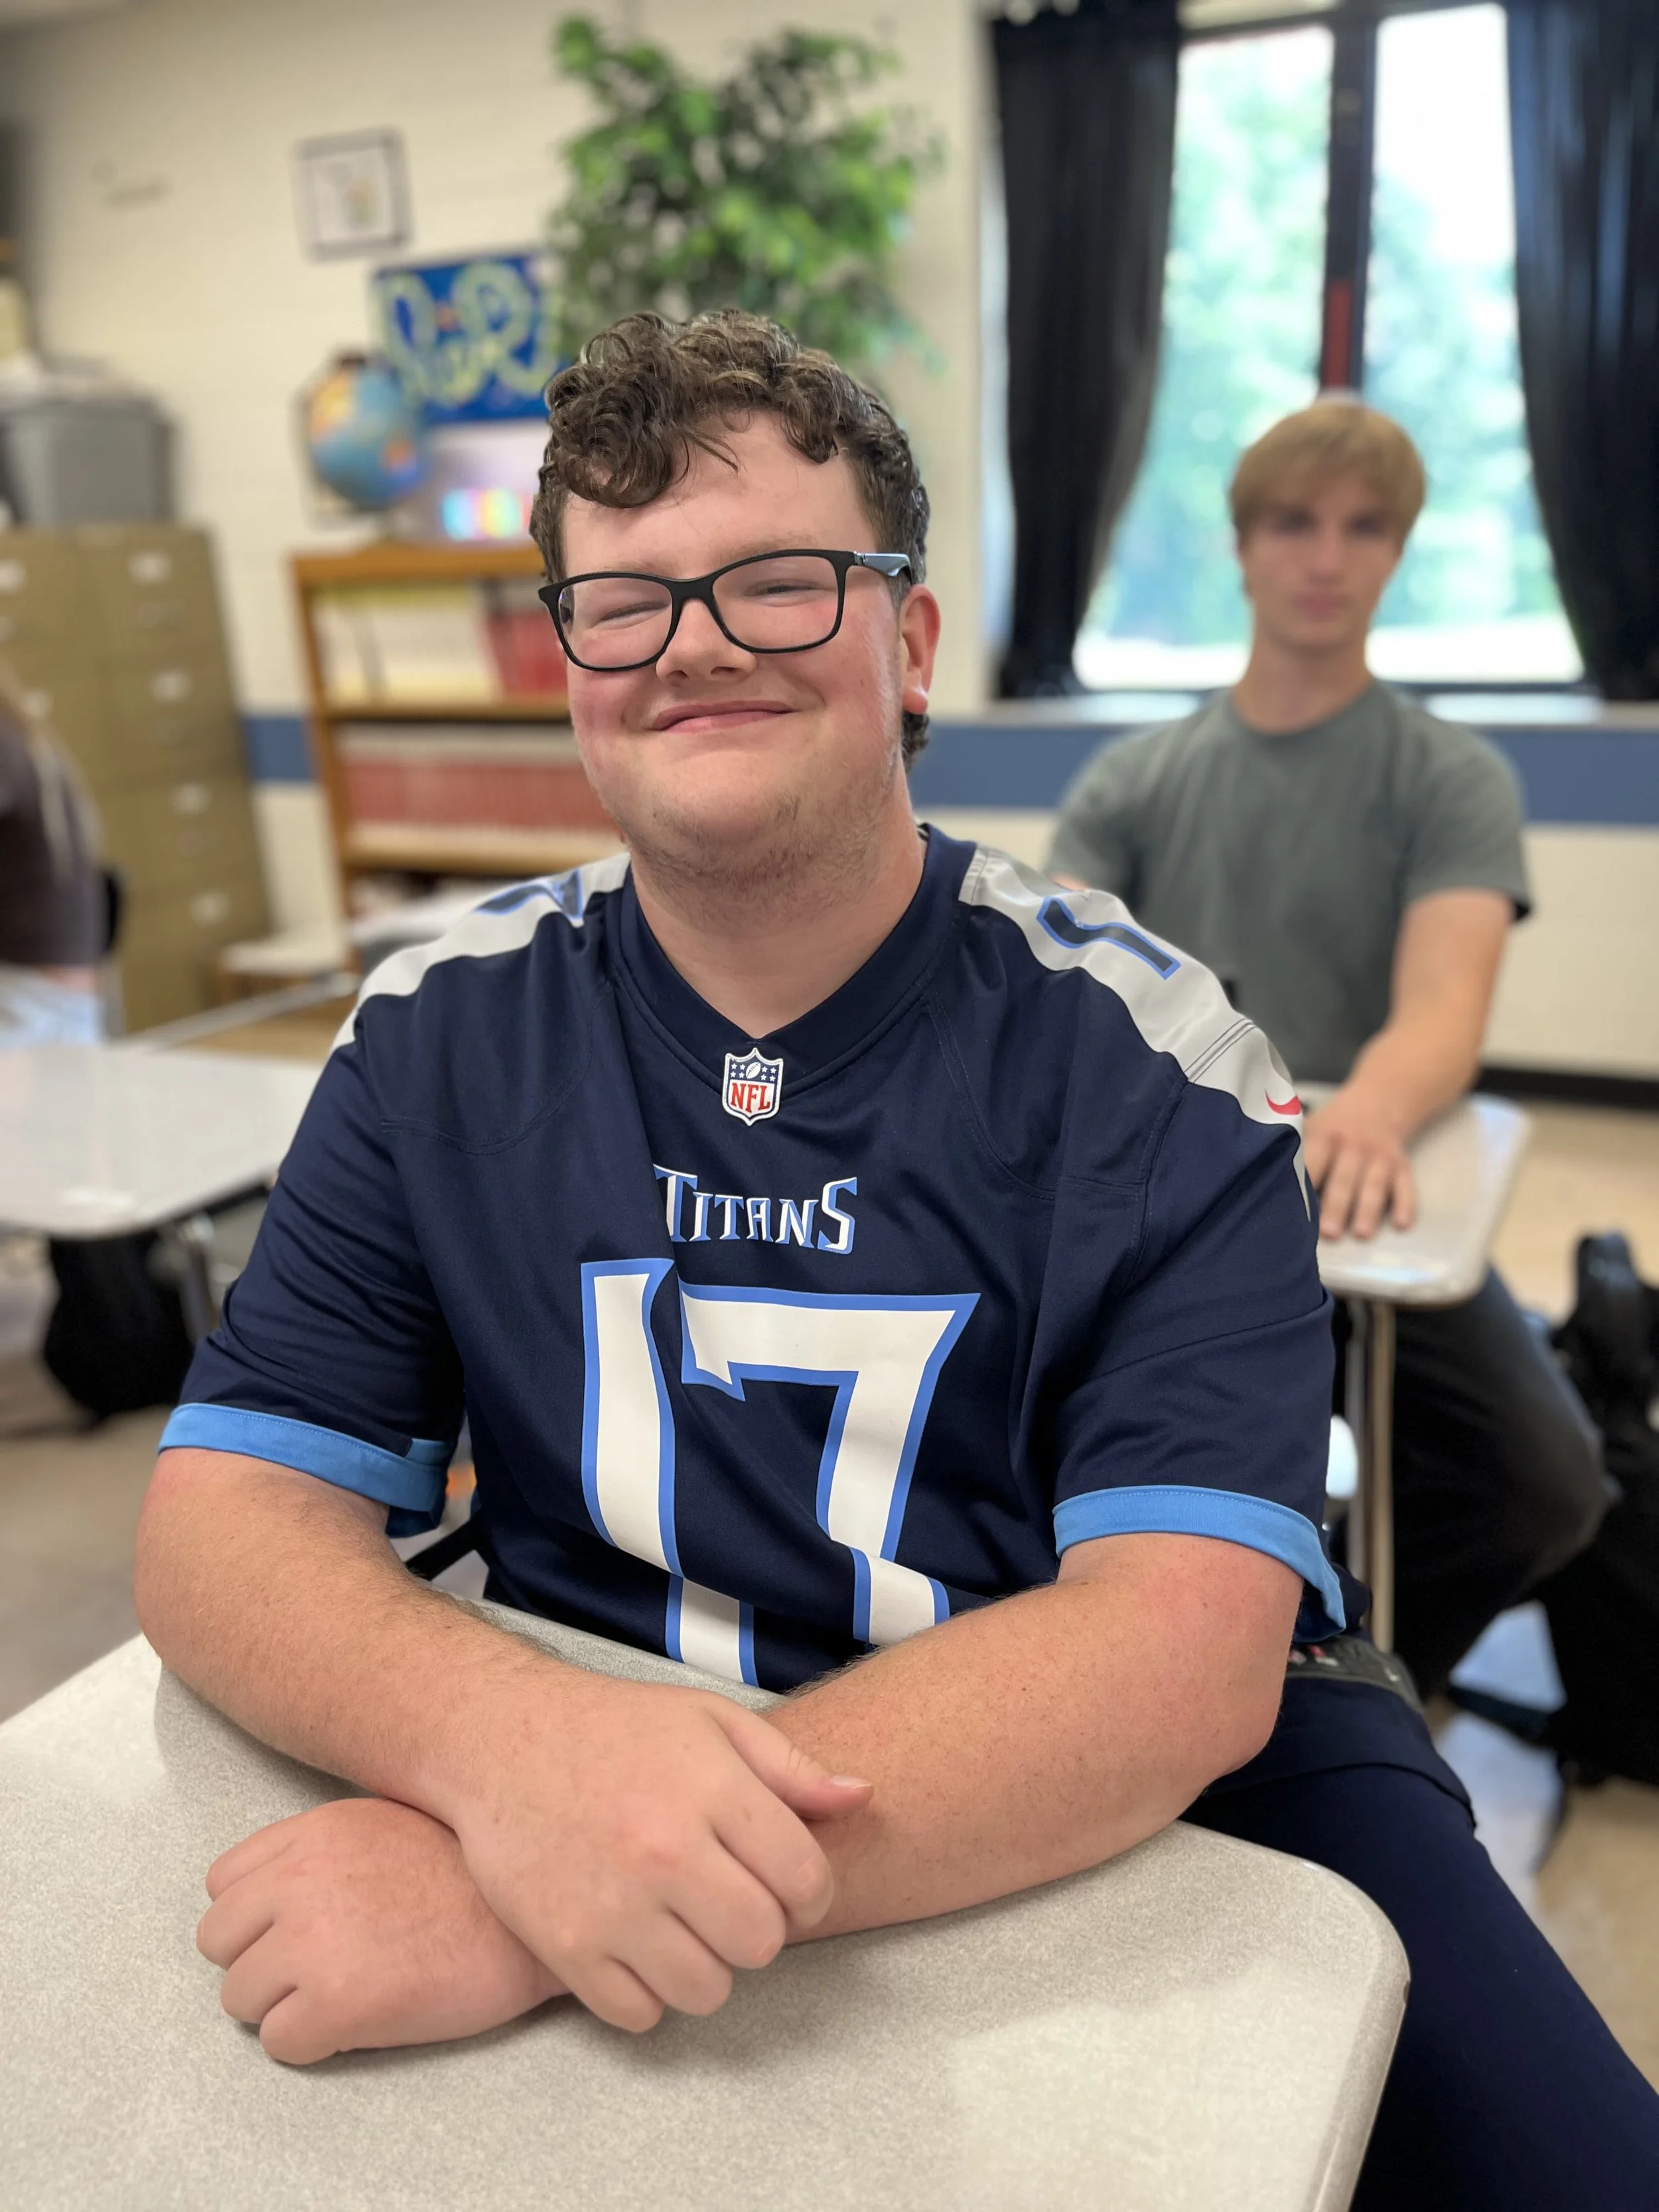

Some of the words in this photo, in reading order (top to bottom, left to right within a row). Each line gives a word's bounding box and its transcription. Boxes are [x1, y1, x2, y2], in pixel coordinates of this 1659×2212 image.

[730, 1082, 771, 1114] NFL
[653, 1163, 858, 1255] TITANS
[581, 1258, 981, 1688] 17
